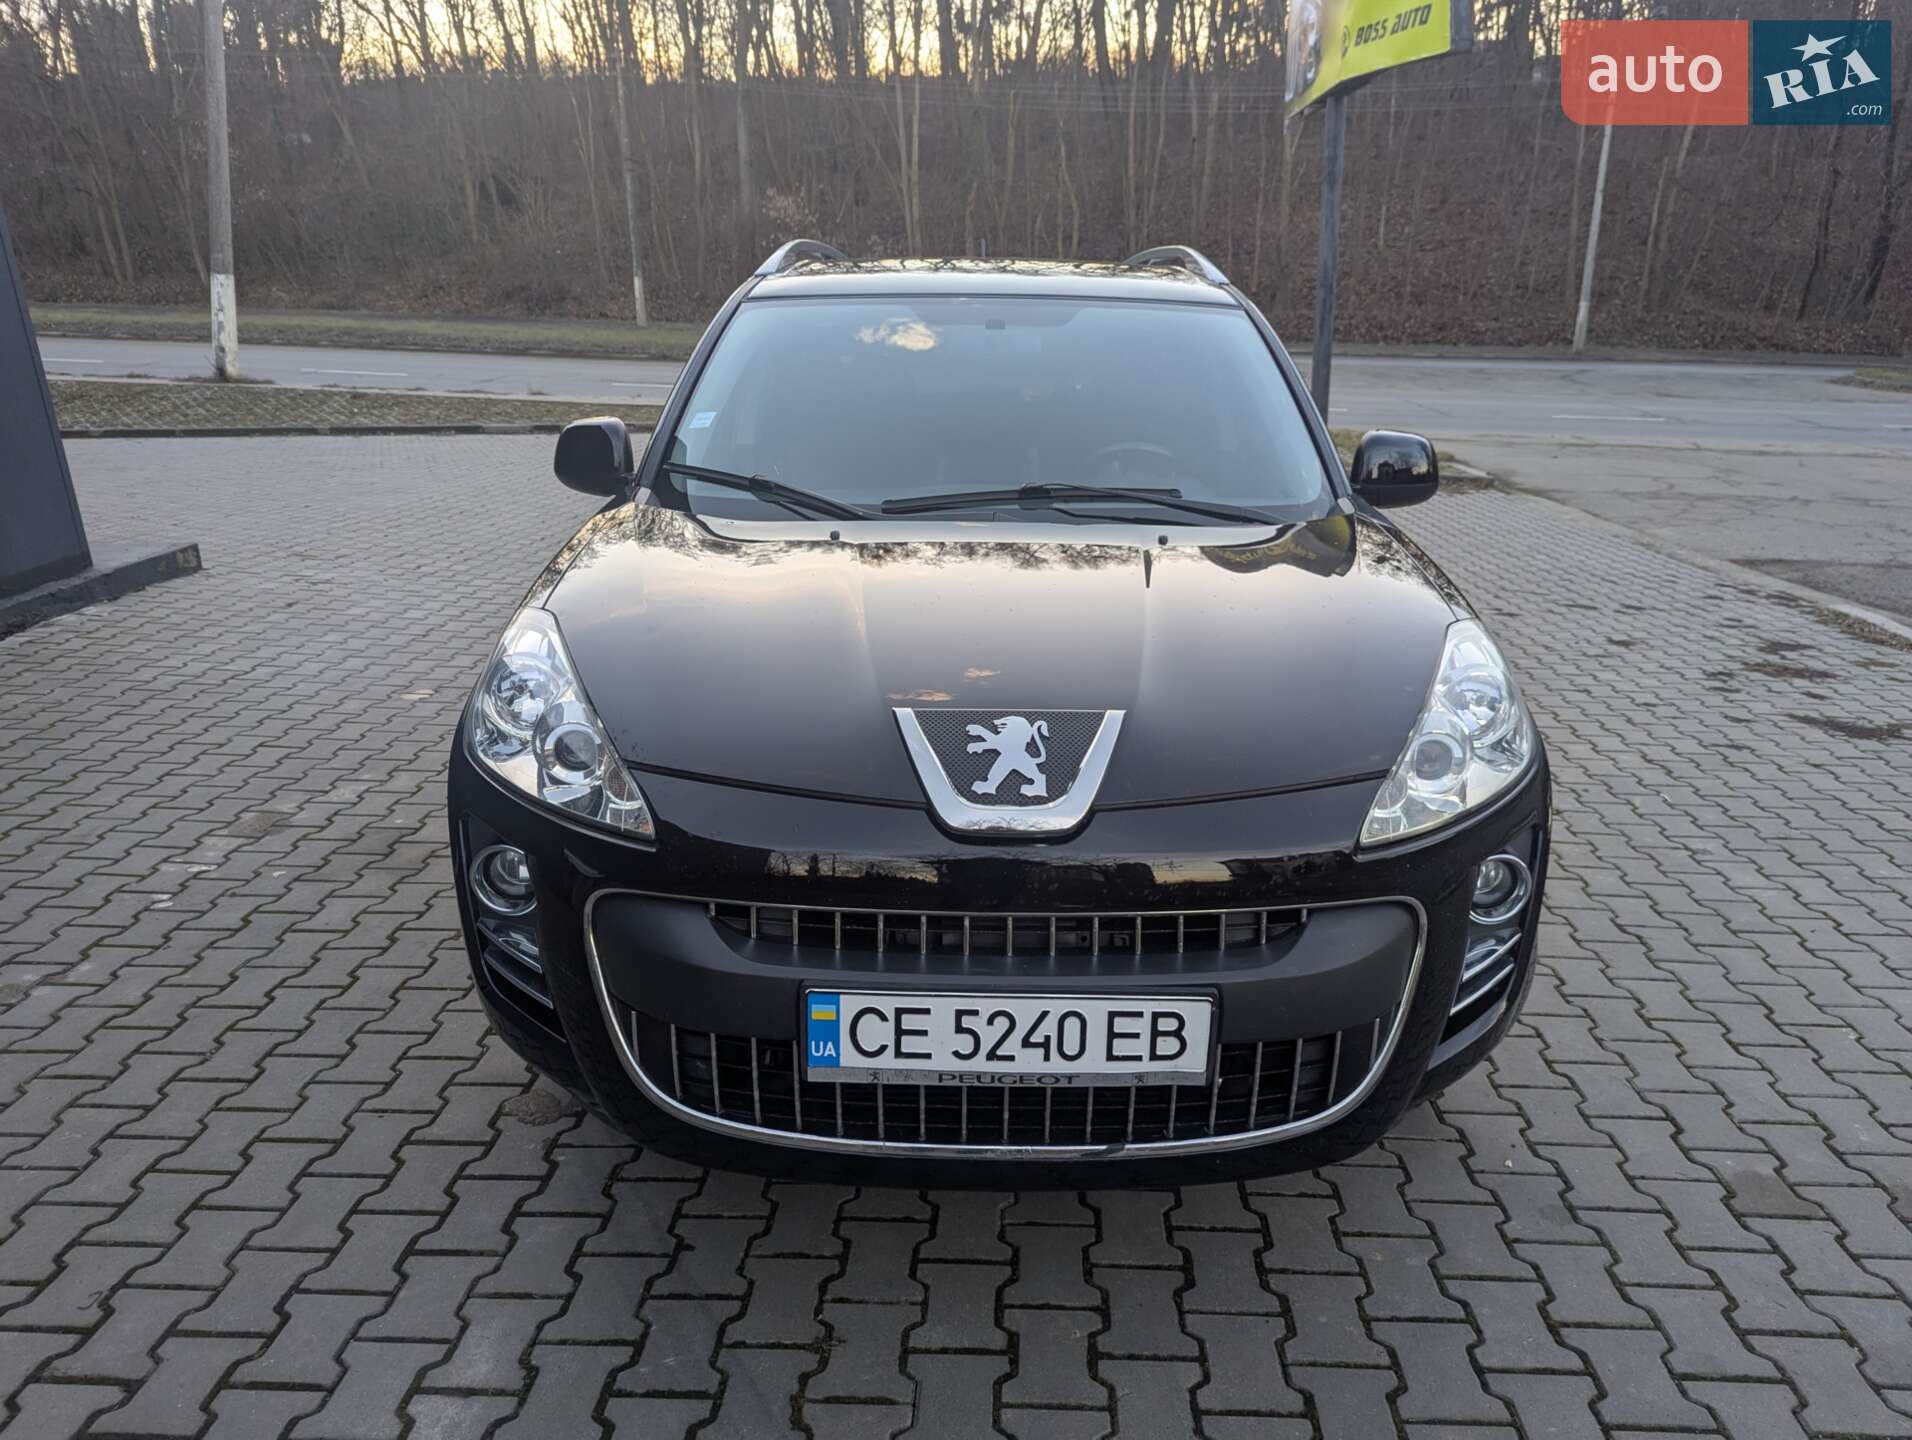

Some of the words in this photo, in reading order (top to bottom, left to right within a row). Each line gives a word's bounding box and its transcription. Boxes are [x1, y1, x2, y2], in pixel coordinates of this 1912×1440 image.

[1354, 18, 1389, 47] BOSS
[849, 1006, 932, 1059] CE
[951, 1008, 1087, 1062] 5240
[1106, 1010, 1187, 1062] EB
[811, 1041, 836, 1057] UA
[938, 1073, 1080, 1086] PEUGEOT
